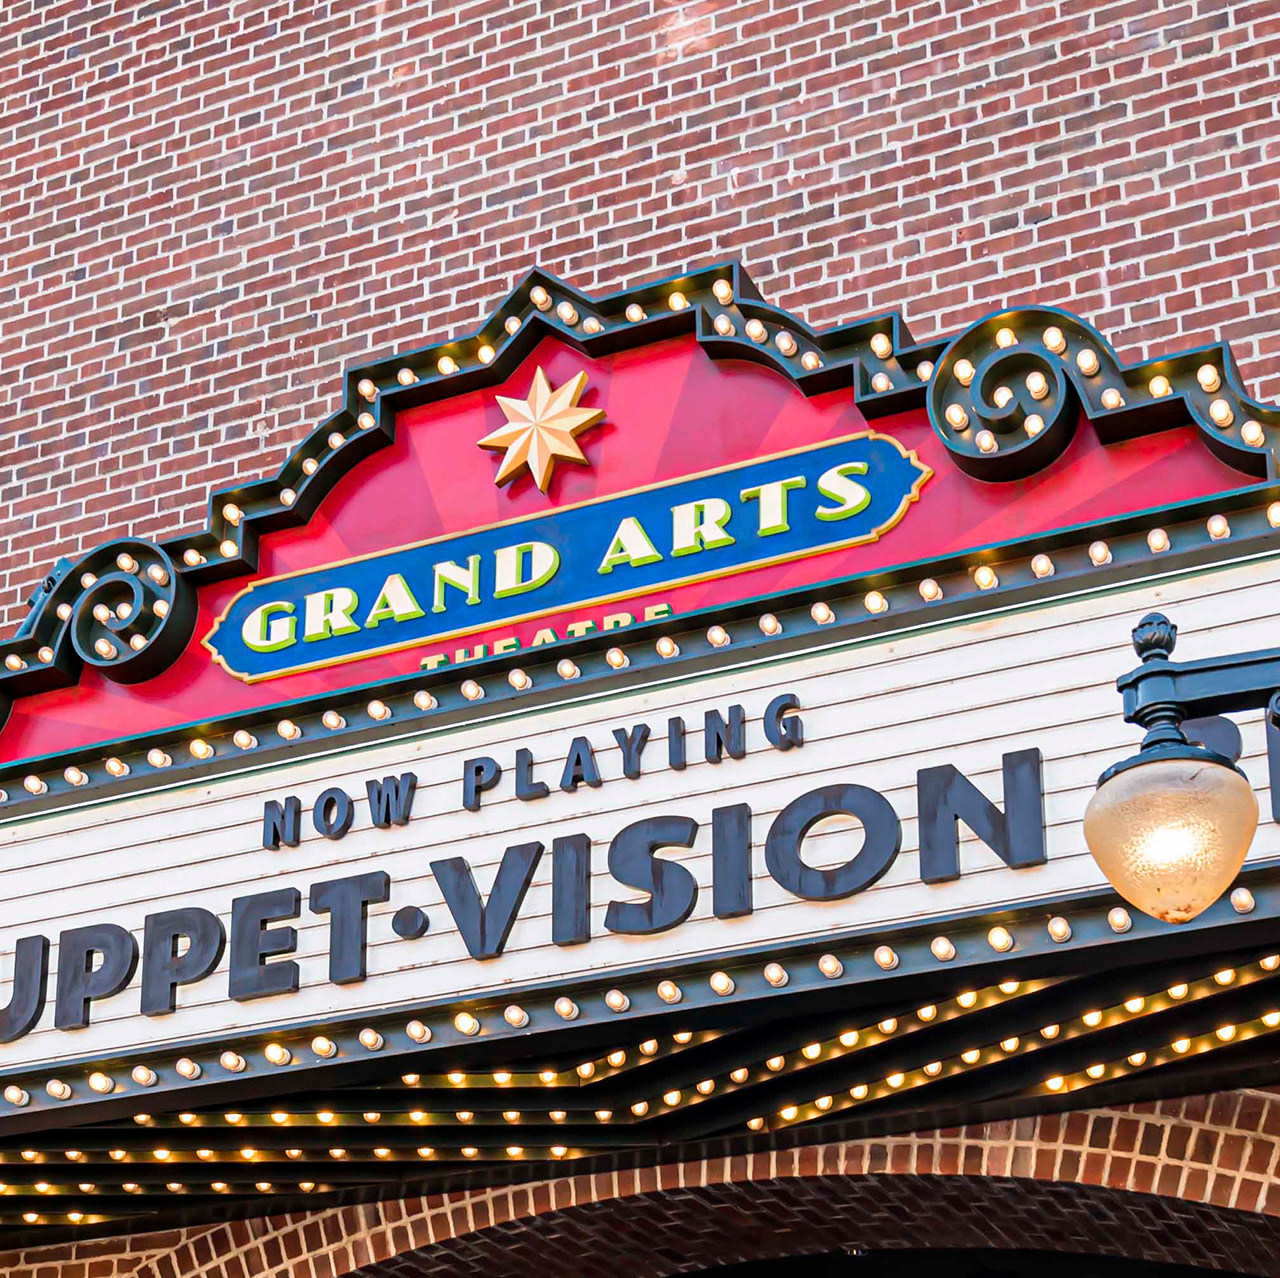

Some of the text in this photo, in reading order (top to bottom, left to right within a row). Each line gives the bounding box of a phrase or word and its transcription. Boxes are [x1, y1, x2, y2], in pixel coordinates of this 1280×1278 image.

[241, 461, 871, 653] GRAND ARTS
[262, 692, 804, 852] NOW PLAYING
